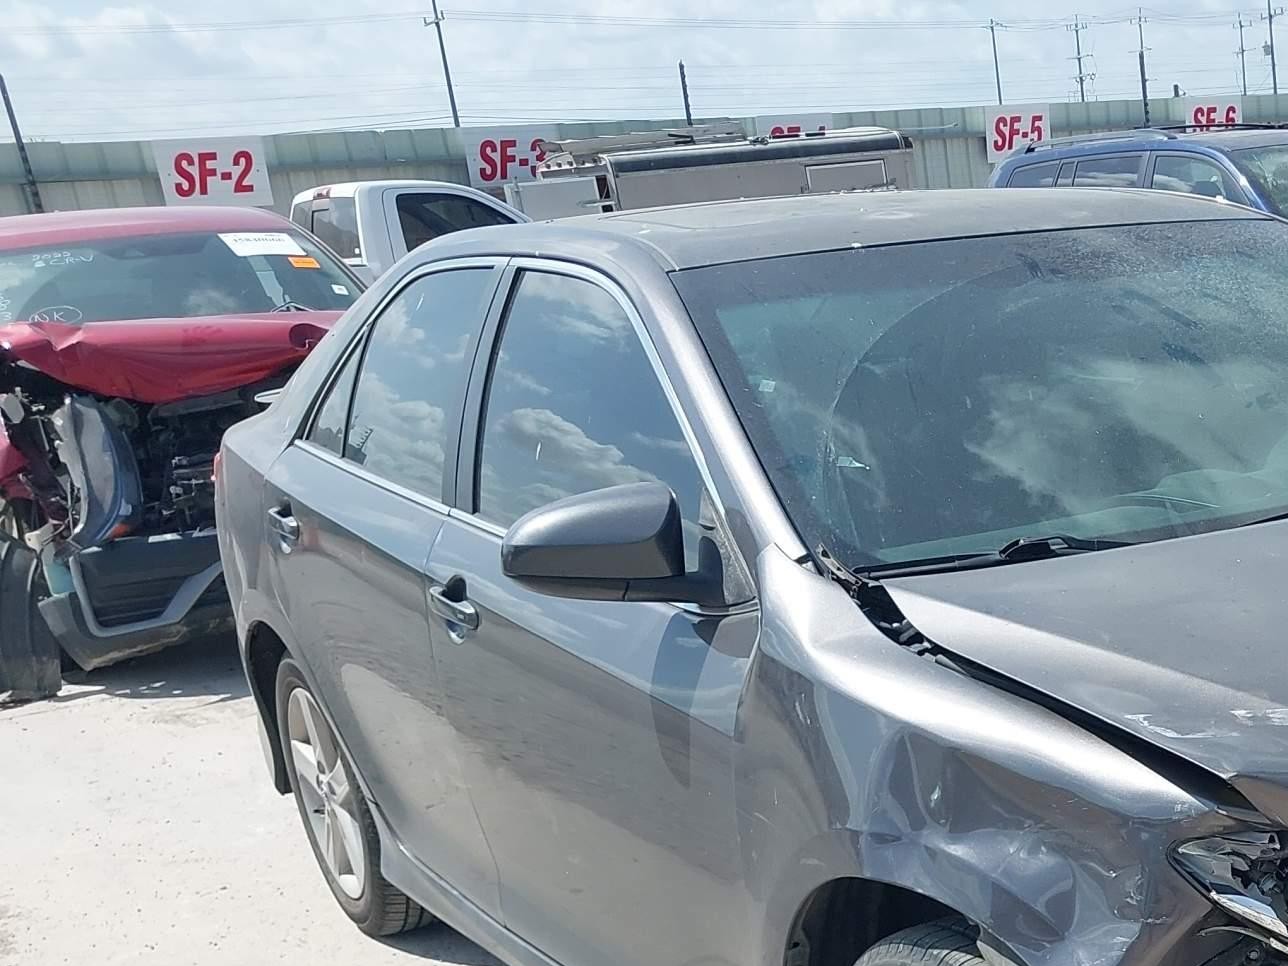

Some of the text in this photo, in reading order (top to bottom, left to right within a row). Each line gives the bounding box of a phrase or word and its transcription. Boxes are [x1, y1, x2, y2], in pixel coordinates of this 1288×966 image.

[993, 114, 1044, 153] SF-5
[1193, 105, 1237, 132] SF-6
[173, 149, 254, 198] SF-2
